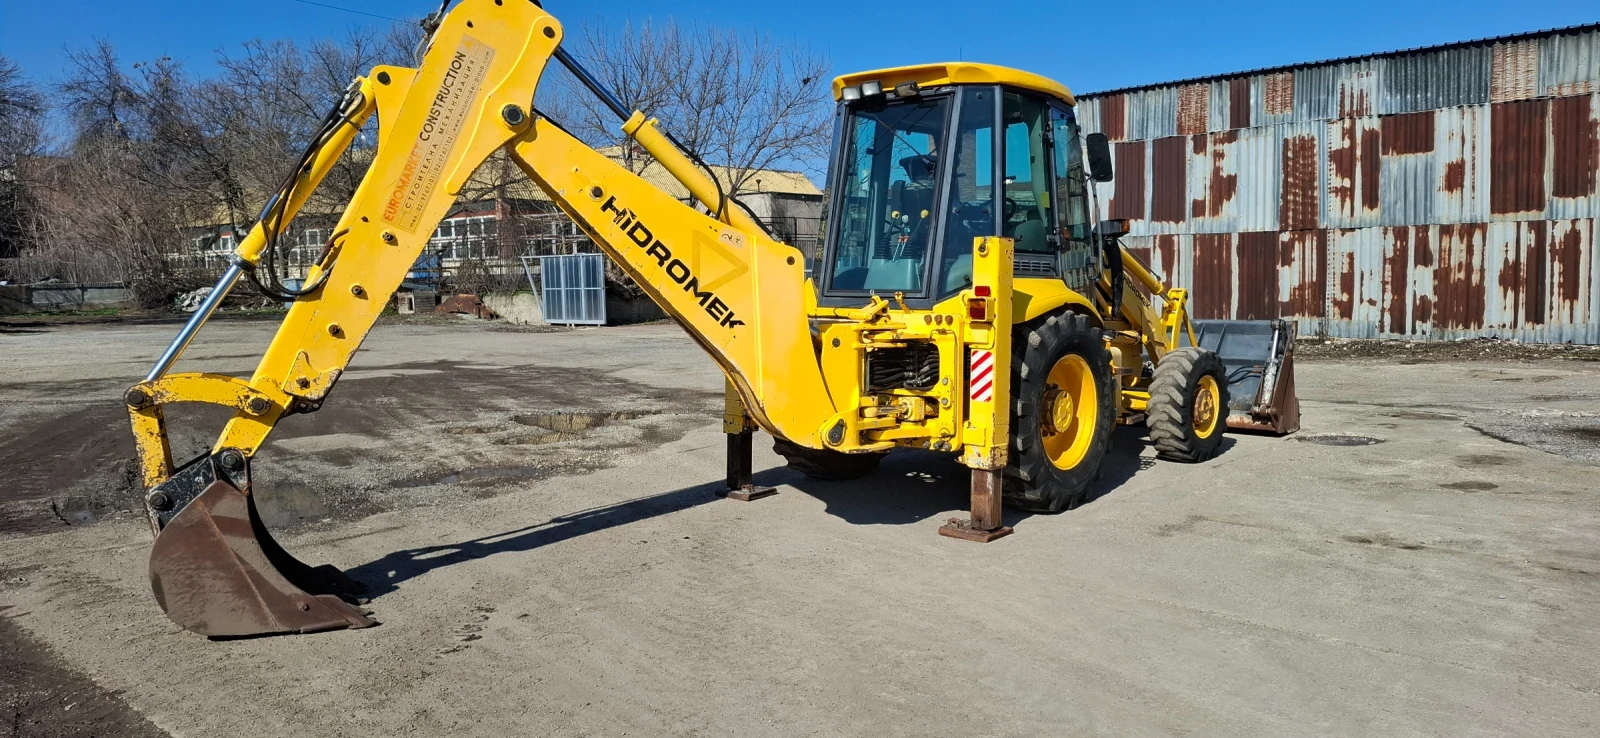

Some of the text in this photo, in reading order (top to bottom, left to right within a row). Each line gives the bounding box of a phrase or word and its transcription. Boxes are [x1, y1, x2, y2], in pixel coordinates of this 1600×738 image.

[383, 51, 466, 221] EUROMARKET CONSTRUCTION
[405, 59, 475, 209] СТРОИТЕЛНА МЕХАНИЗАЦИЯ
